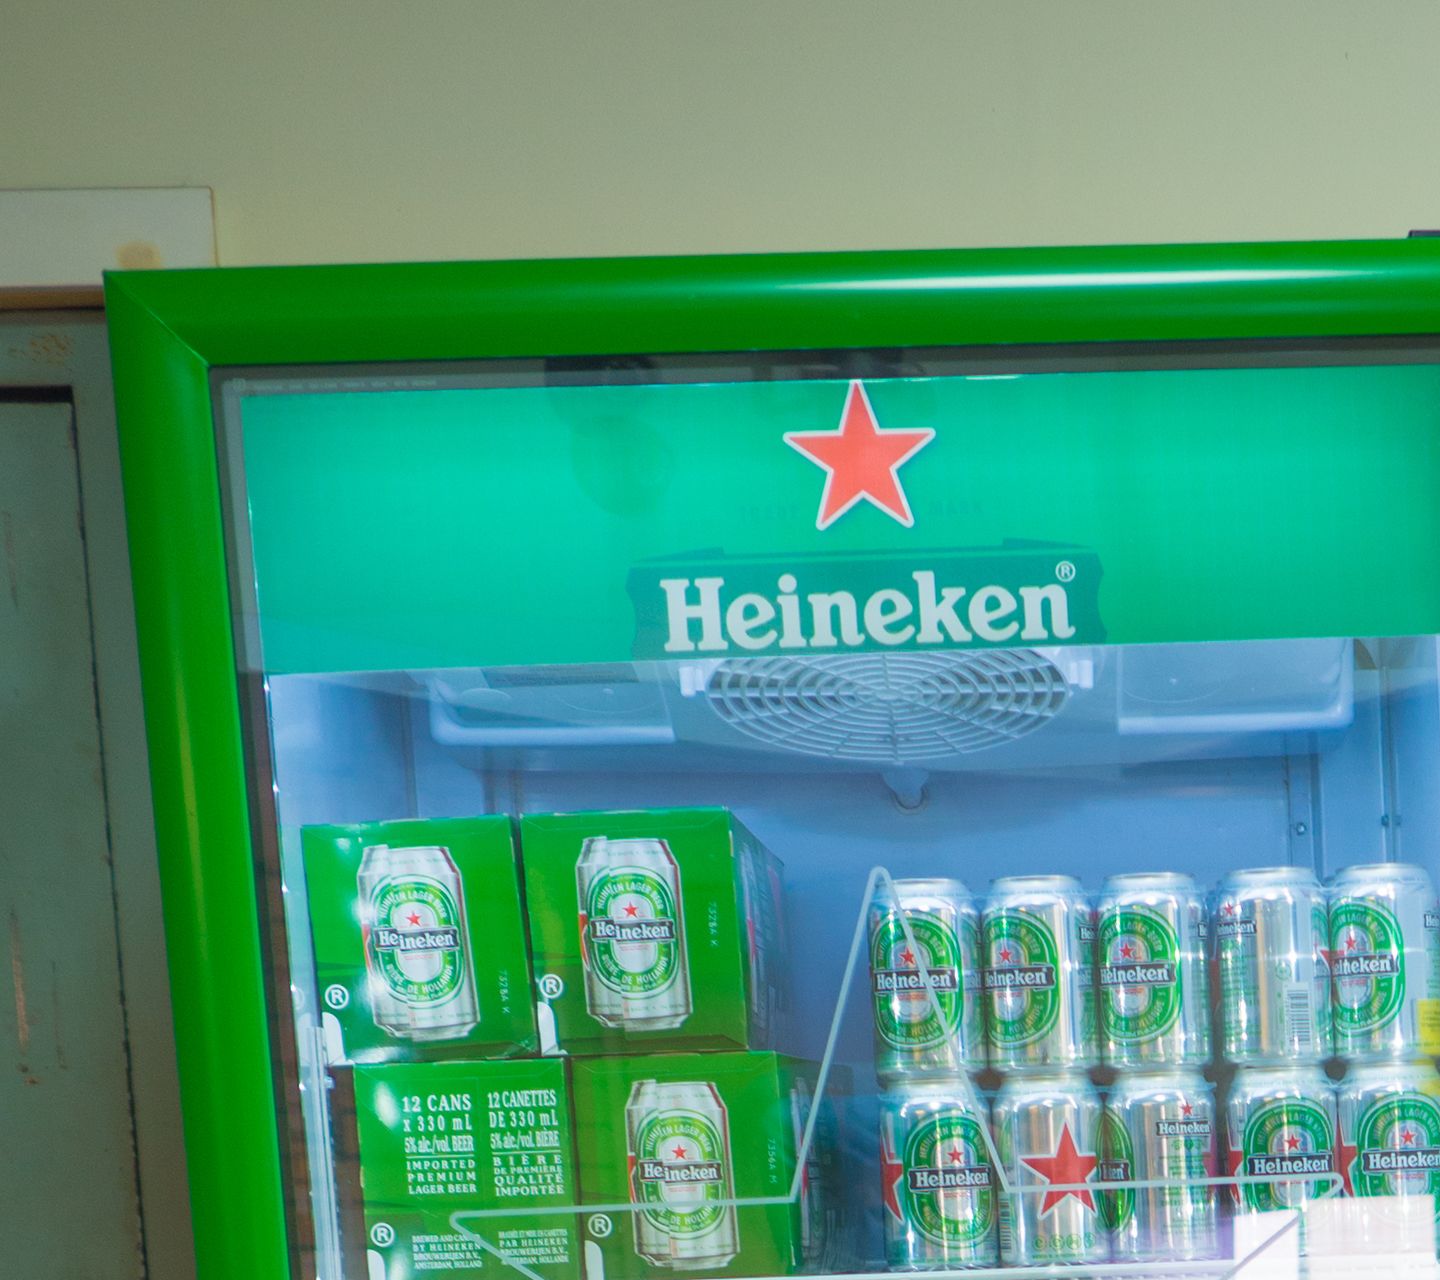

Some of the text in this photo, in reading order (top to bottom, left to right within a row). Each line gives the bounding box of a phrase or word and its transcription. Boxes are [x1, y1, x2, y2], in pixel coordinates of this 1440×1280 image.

[660, 571, 1076, 653] Heineken
[596, 921, 669, 940] Heineken
[379, 931, 454, 950] Heineken
[402, 1094, 471, 1112] 12 CANS
[488, 1089, 557, 1109] 12 CANETTES
[418, 1115, 445, 1132] 330
[489, 1111, 535, 1128] DE 330
[1158, 1122, 1211, 1135] Heineken
[452, 1135, 474, 1152] BEER
[535, 1128, 559, 1147] BIÈRE
[406, 1160, 475, 1170] IMPORTED
[645, 1162, 717, 1181] Heineken
[1254, 1156, 1329, 1175] Heineken
[407, 1172, 476, 1182] PREMIUM
[494, 1173, 563, 1185] QUALITÉ
[916, 1168, 990, 1188] Heineken
[408, 1184, 476, 1195] LAGER BEER
[495, 1185, 564, 1197] IMPORTÉE
